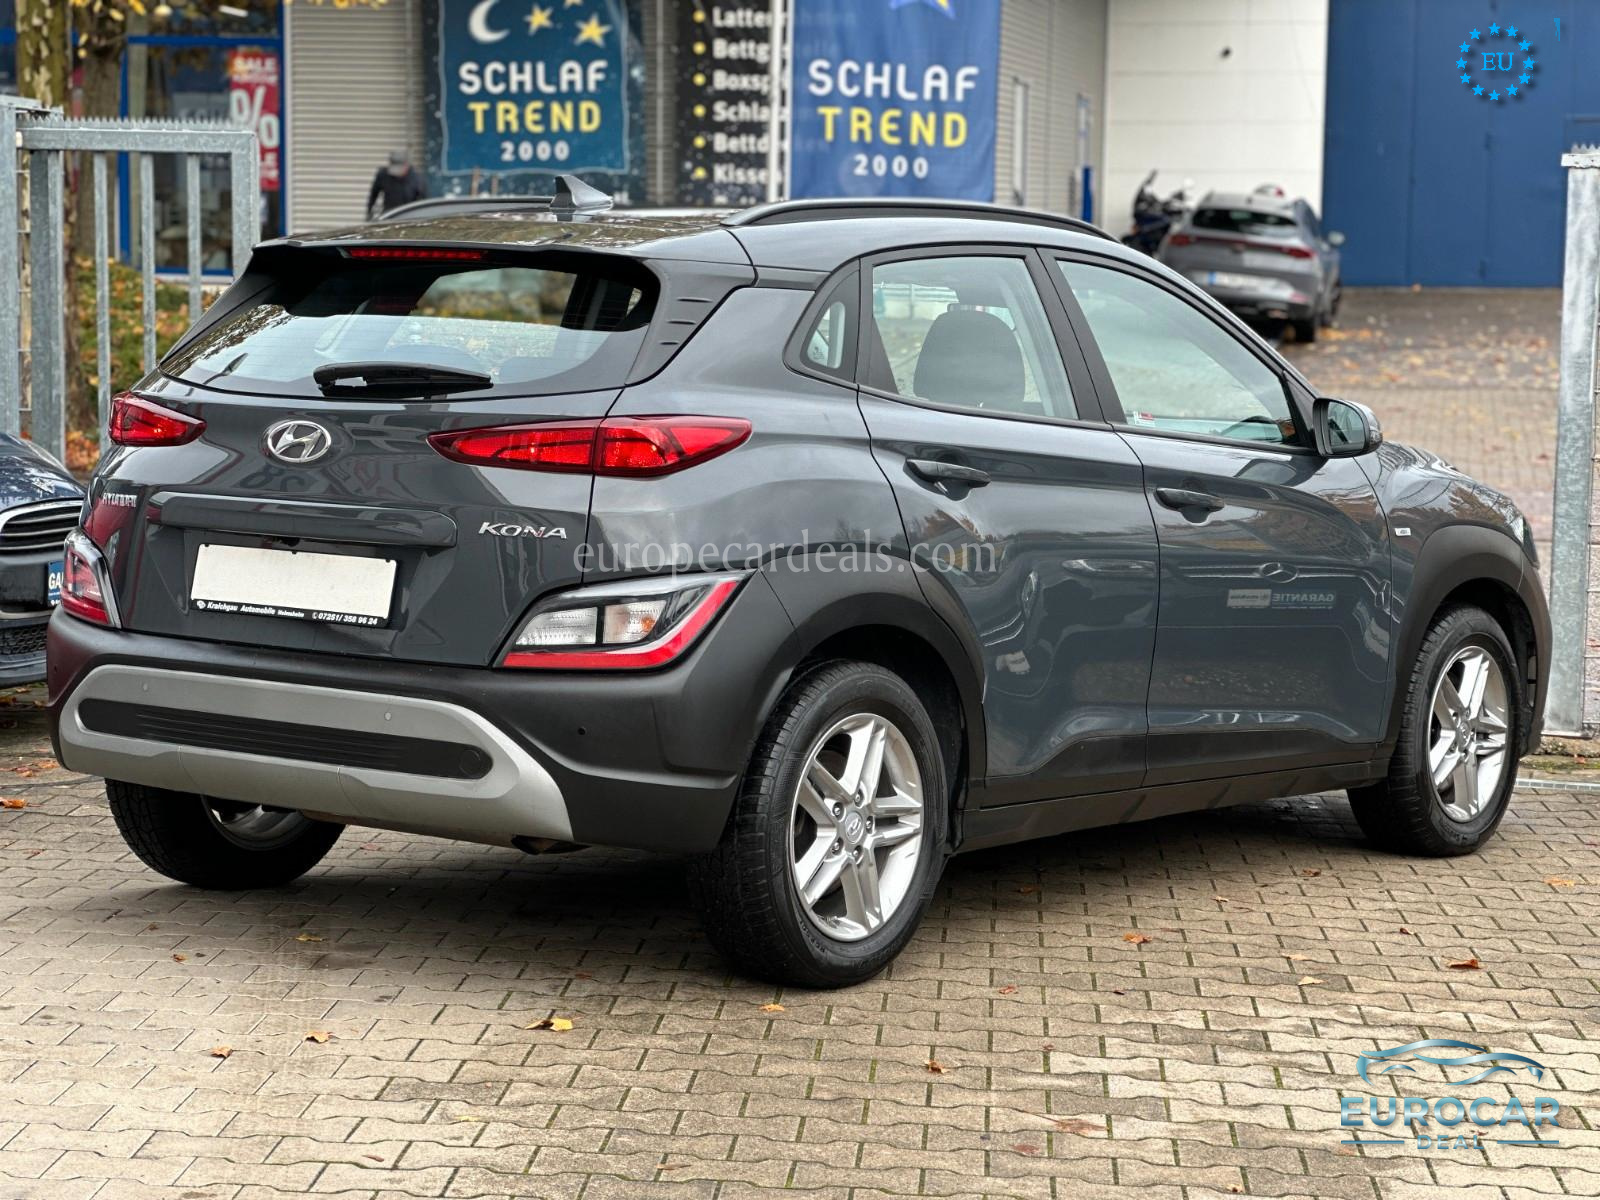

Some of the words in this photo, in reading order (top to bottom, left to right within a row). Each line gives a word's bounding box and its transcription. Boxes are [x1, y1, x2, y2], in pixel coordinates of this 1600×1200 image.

[713, 37, 771, 64] Bettg
[459, 60, 608, 95] SCHLAF
[713, 68, 771, 95] Boxsp
[808, 59, 979, 101] SCHLAF
[468, 102, 601, 133] TREND
[712, 100, 771, 123] Schla
[817, 106, 968, 147] TREND
[501, 141, 570, 161] 2000
[713, 132, 770, 153] Bettd
[854, 154, 929, 179] 2000
[479, 521, 567, 539] KONA
[207, 601, 238, 611] Kraichgau
[240, 605, 276, 615] Automobile
